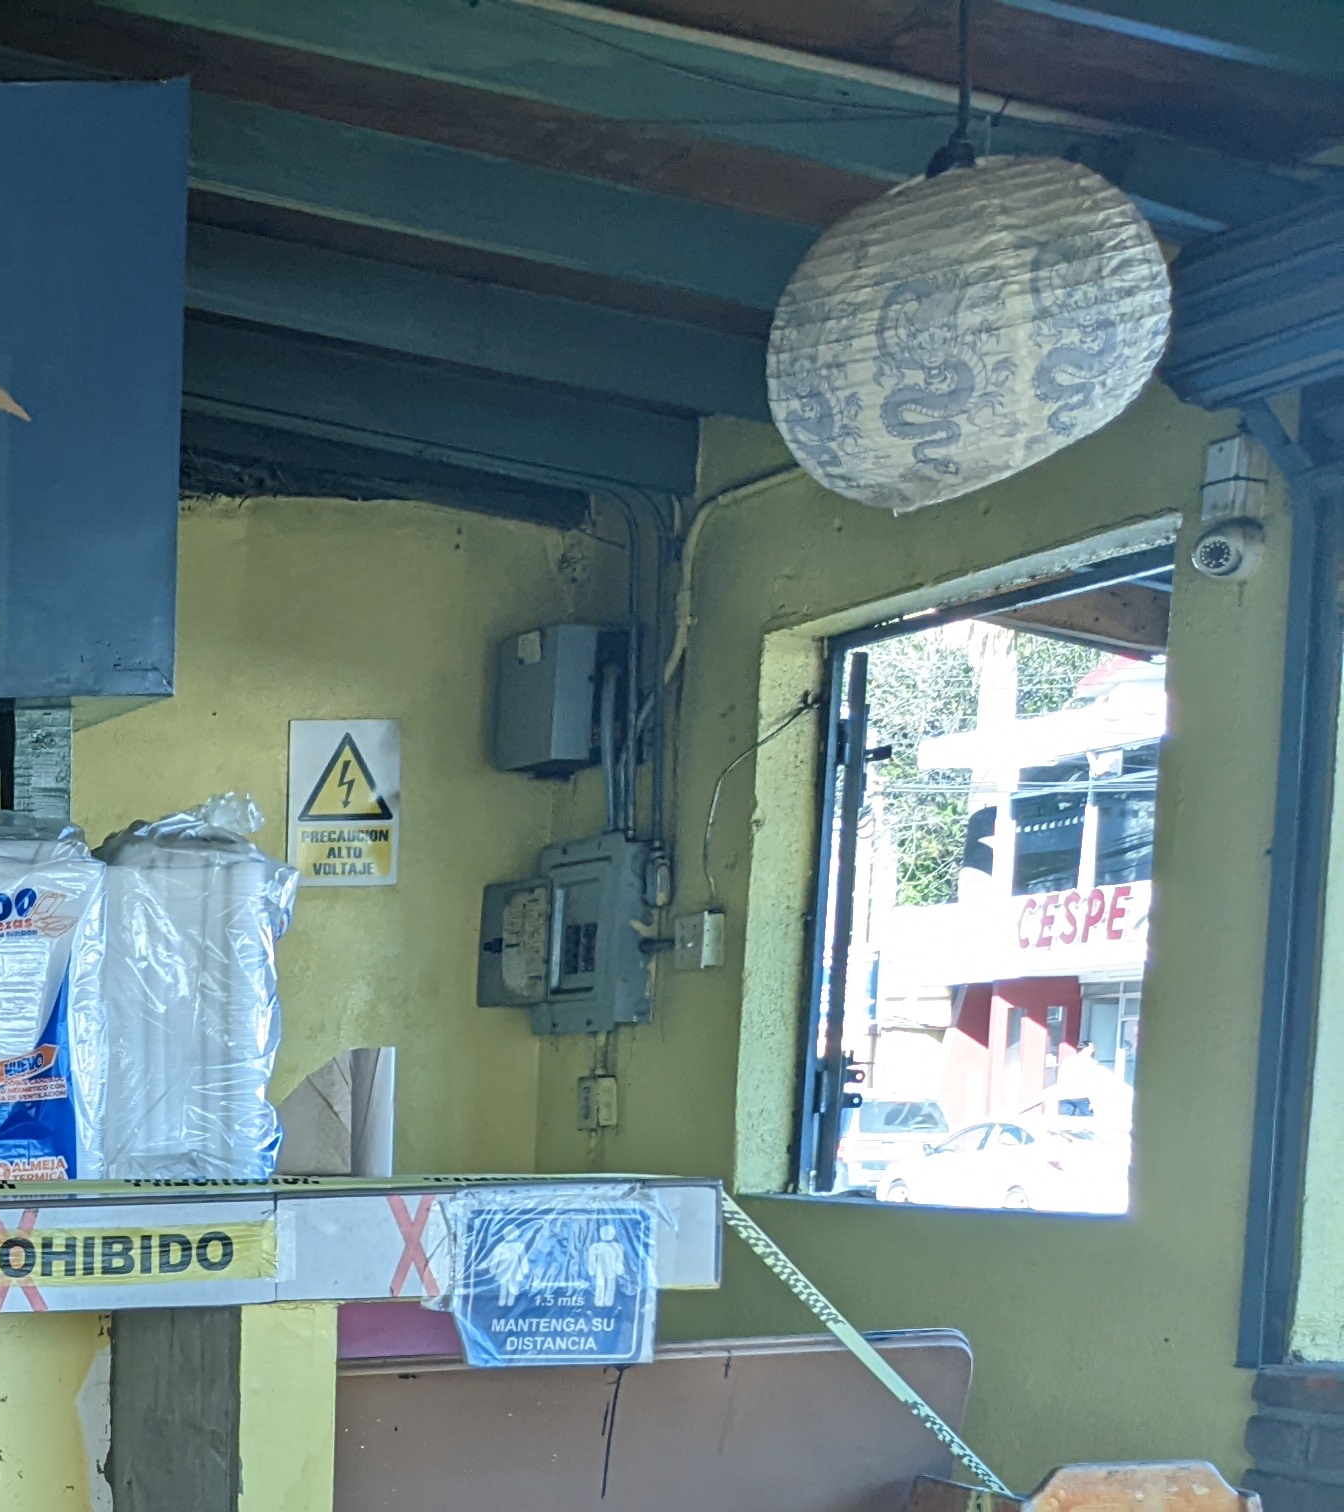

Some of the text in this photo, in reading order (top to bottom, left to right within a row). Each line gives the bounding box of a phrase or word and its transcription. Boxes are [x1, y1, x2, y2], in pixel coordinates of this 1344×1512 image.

[301, 830, 388, 842] PRECAUCION
[327, 847, 361, 859] ALTO
[313, 863, 374, 876] VOLTAJE
[1017, 886, 1131, 949] CESPE
[13, 1158, 66, 1171] ALMEJA
[534, 1295, 585, 1307] 1.5 mts
[491, 1318, 615, 1332] MANTENGA SU
[506, 1336, 597, 1351] DISTANCIA
